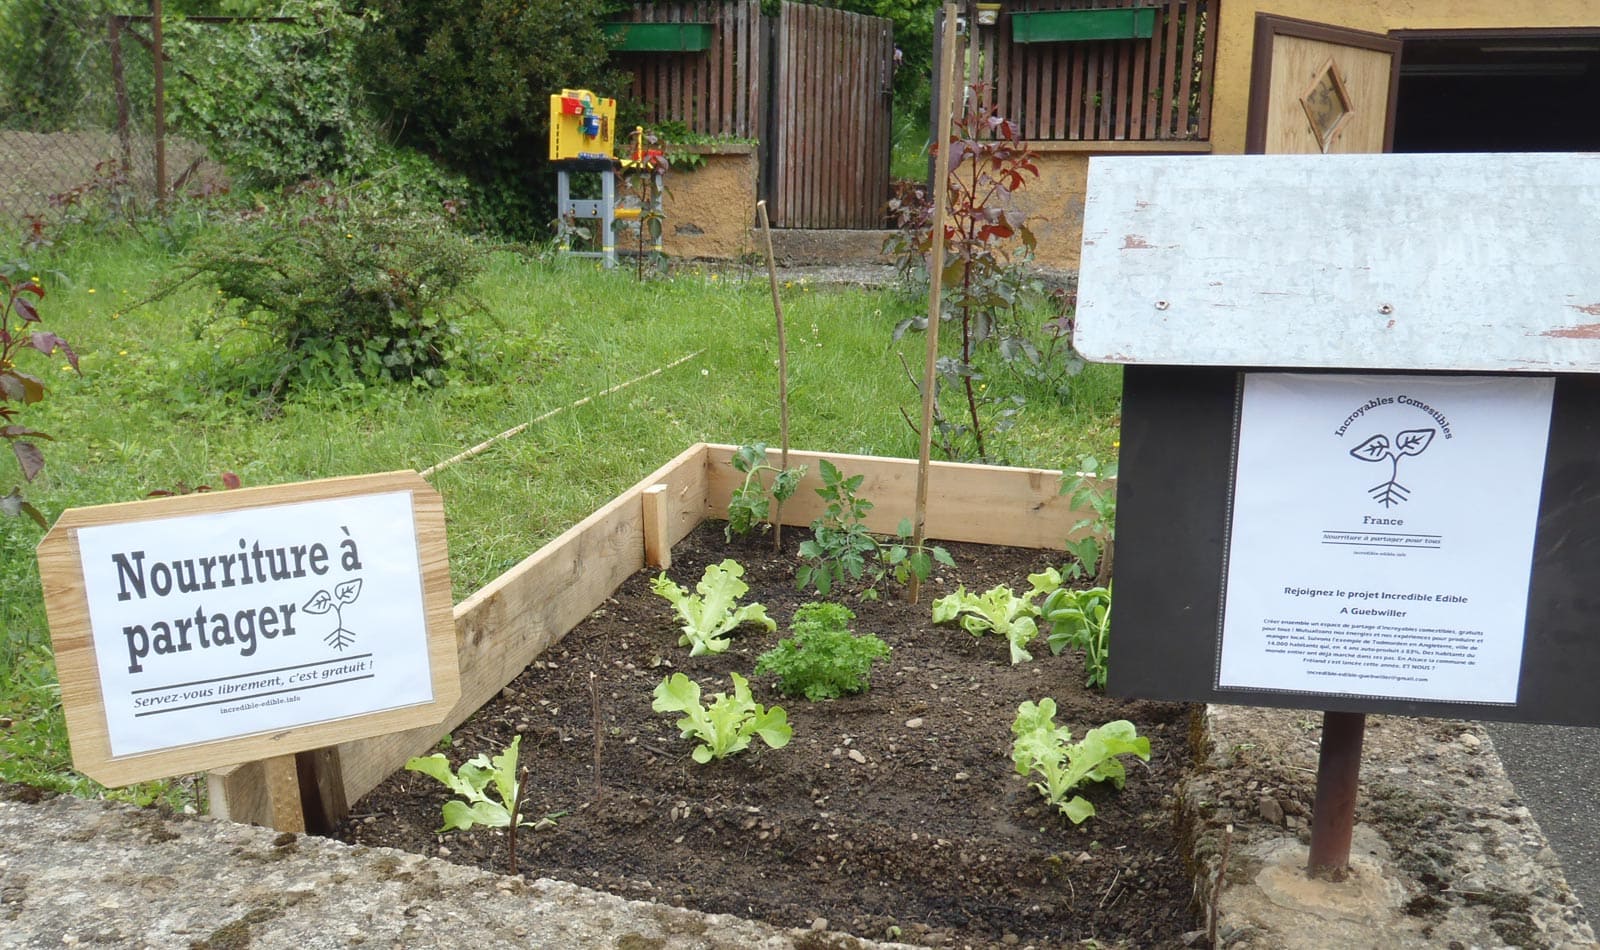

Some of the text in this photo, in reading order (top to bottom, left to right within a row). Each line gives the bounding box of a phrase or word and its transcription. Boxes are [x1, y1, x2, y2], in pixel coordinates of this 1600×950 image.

[1335, 395, 1453, 440] Incroyables Comestibles
[1363, 515, 1404, 526] France
[1370, 536, 1404, 544] partager
[111, 526, 362, 601] Nourriture à
[1284, 586, 1468, 603] Rejoignez le projet Incredible Edible
[1340, 607, 1407, 618] A Guebwiller
[122, 602, 297, 674] partager
[1289, 641, 1318, 649] habitants
[133, 660, 373, 708] Servez-vous librement, c'est gratuit !
[220, 695, 301, 714] incredible-edible.info
